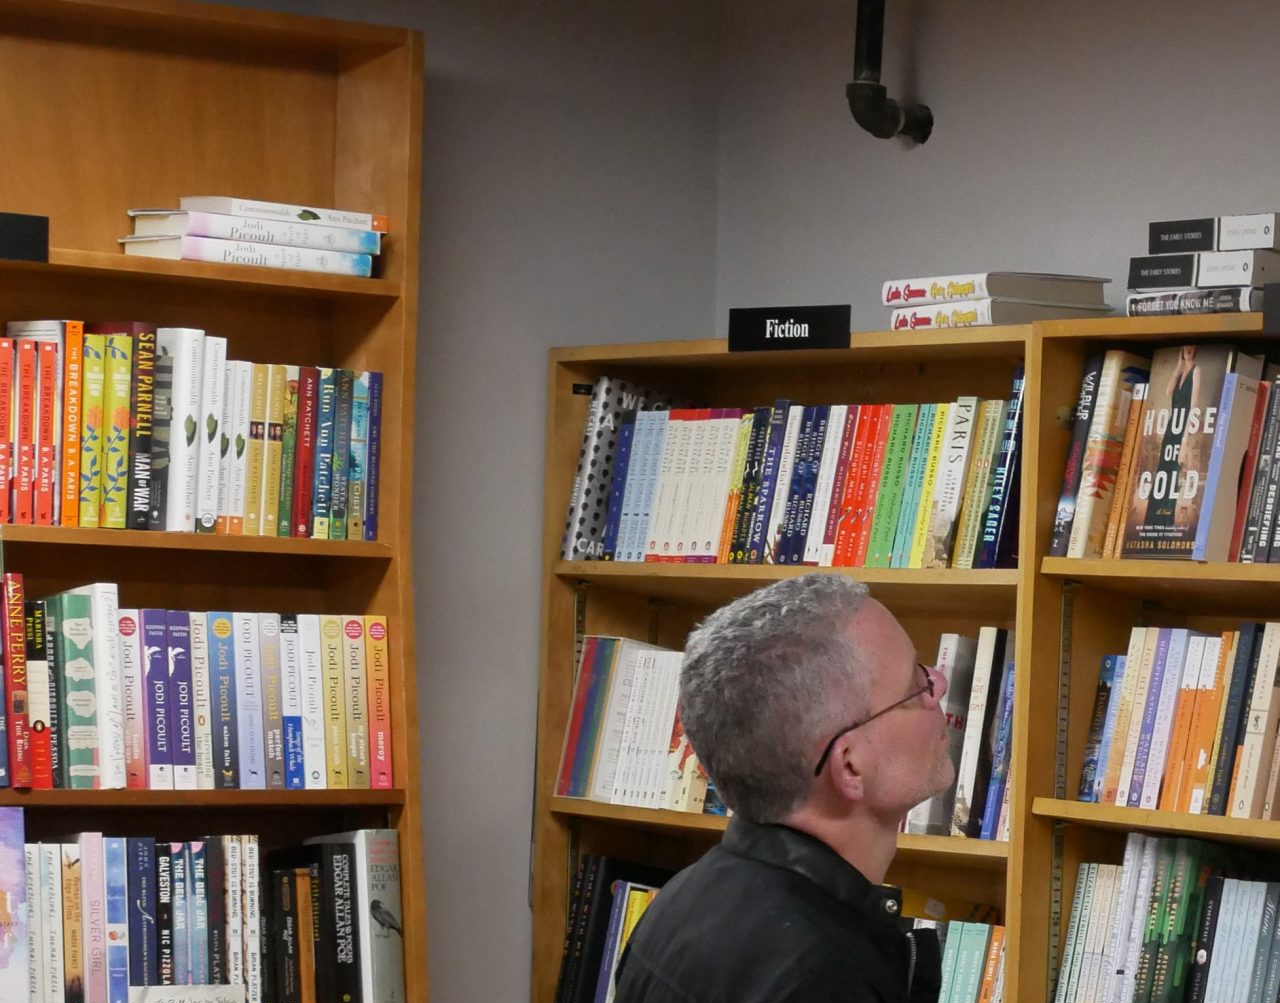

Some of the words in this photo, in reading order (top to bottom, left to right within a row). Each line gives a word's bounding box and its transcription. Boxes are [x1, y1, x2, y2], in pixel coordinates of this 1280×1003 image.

[230, 227, 275, 242] Picoult
[242, 220, 264, 232] Jodi
[1138, 296, 1162, 313] FORGET
[1166, 298, 1178, 310] YOU
[1181, 297, 1199, 309] KNOW
[1201, 297, 1214, 308] ME
[765, 318, 810, 339] Fiction
[138, 333, 153, 372] SEAN
[67, 362, 78, 444] BREAKDOWN
[136, 377, 153, 436] PARNELL
[322, 384, 334, 412] Run
[947, 403, 972, 465] PARIS
[1143, 407, 1217, 436] HOUSE
[133, 453, 149, 478] MAN
[1164, 444, 1181, 462] OF
[67, 474, 75, 501] PARIS
[316, 450, 330, 513] Patchett
[1138, 471, 1200, 499] GOLD
[132, 489, 149, 513] WAR
[8, 581, 23, 627] ANNE
[10, 635, 26, 686] PERRY
[155, 680, 164, 704] JODI
[157, 708, 167, 752] PICOULT
[159, 856, 169, 903] GALVESTON
